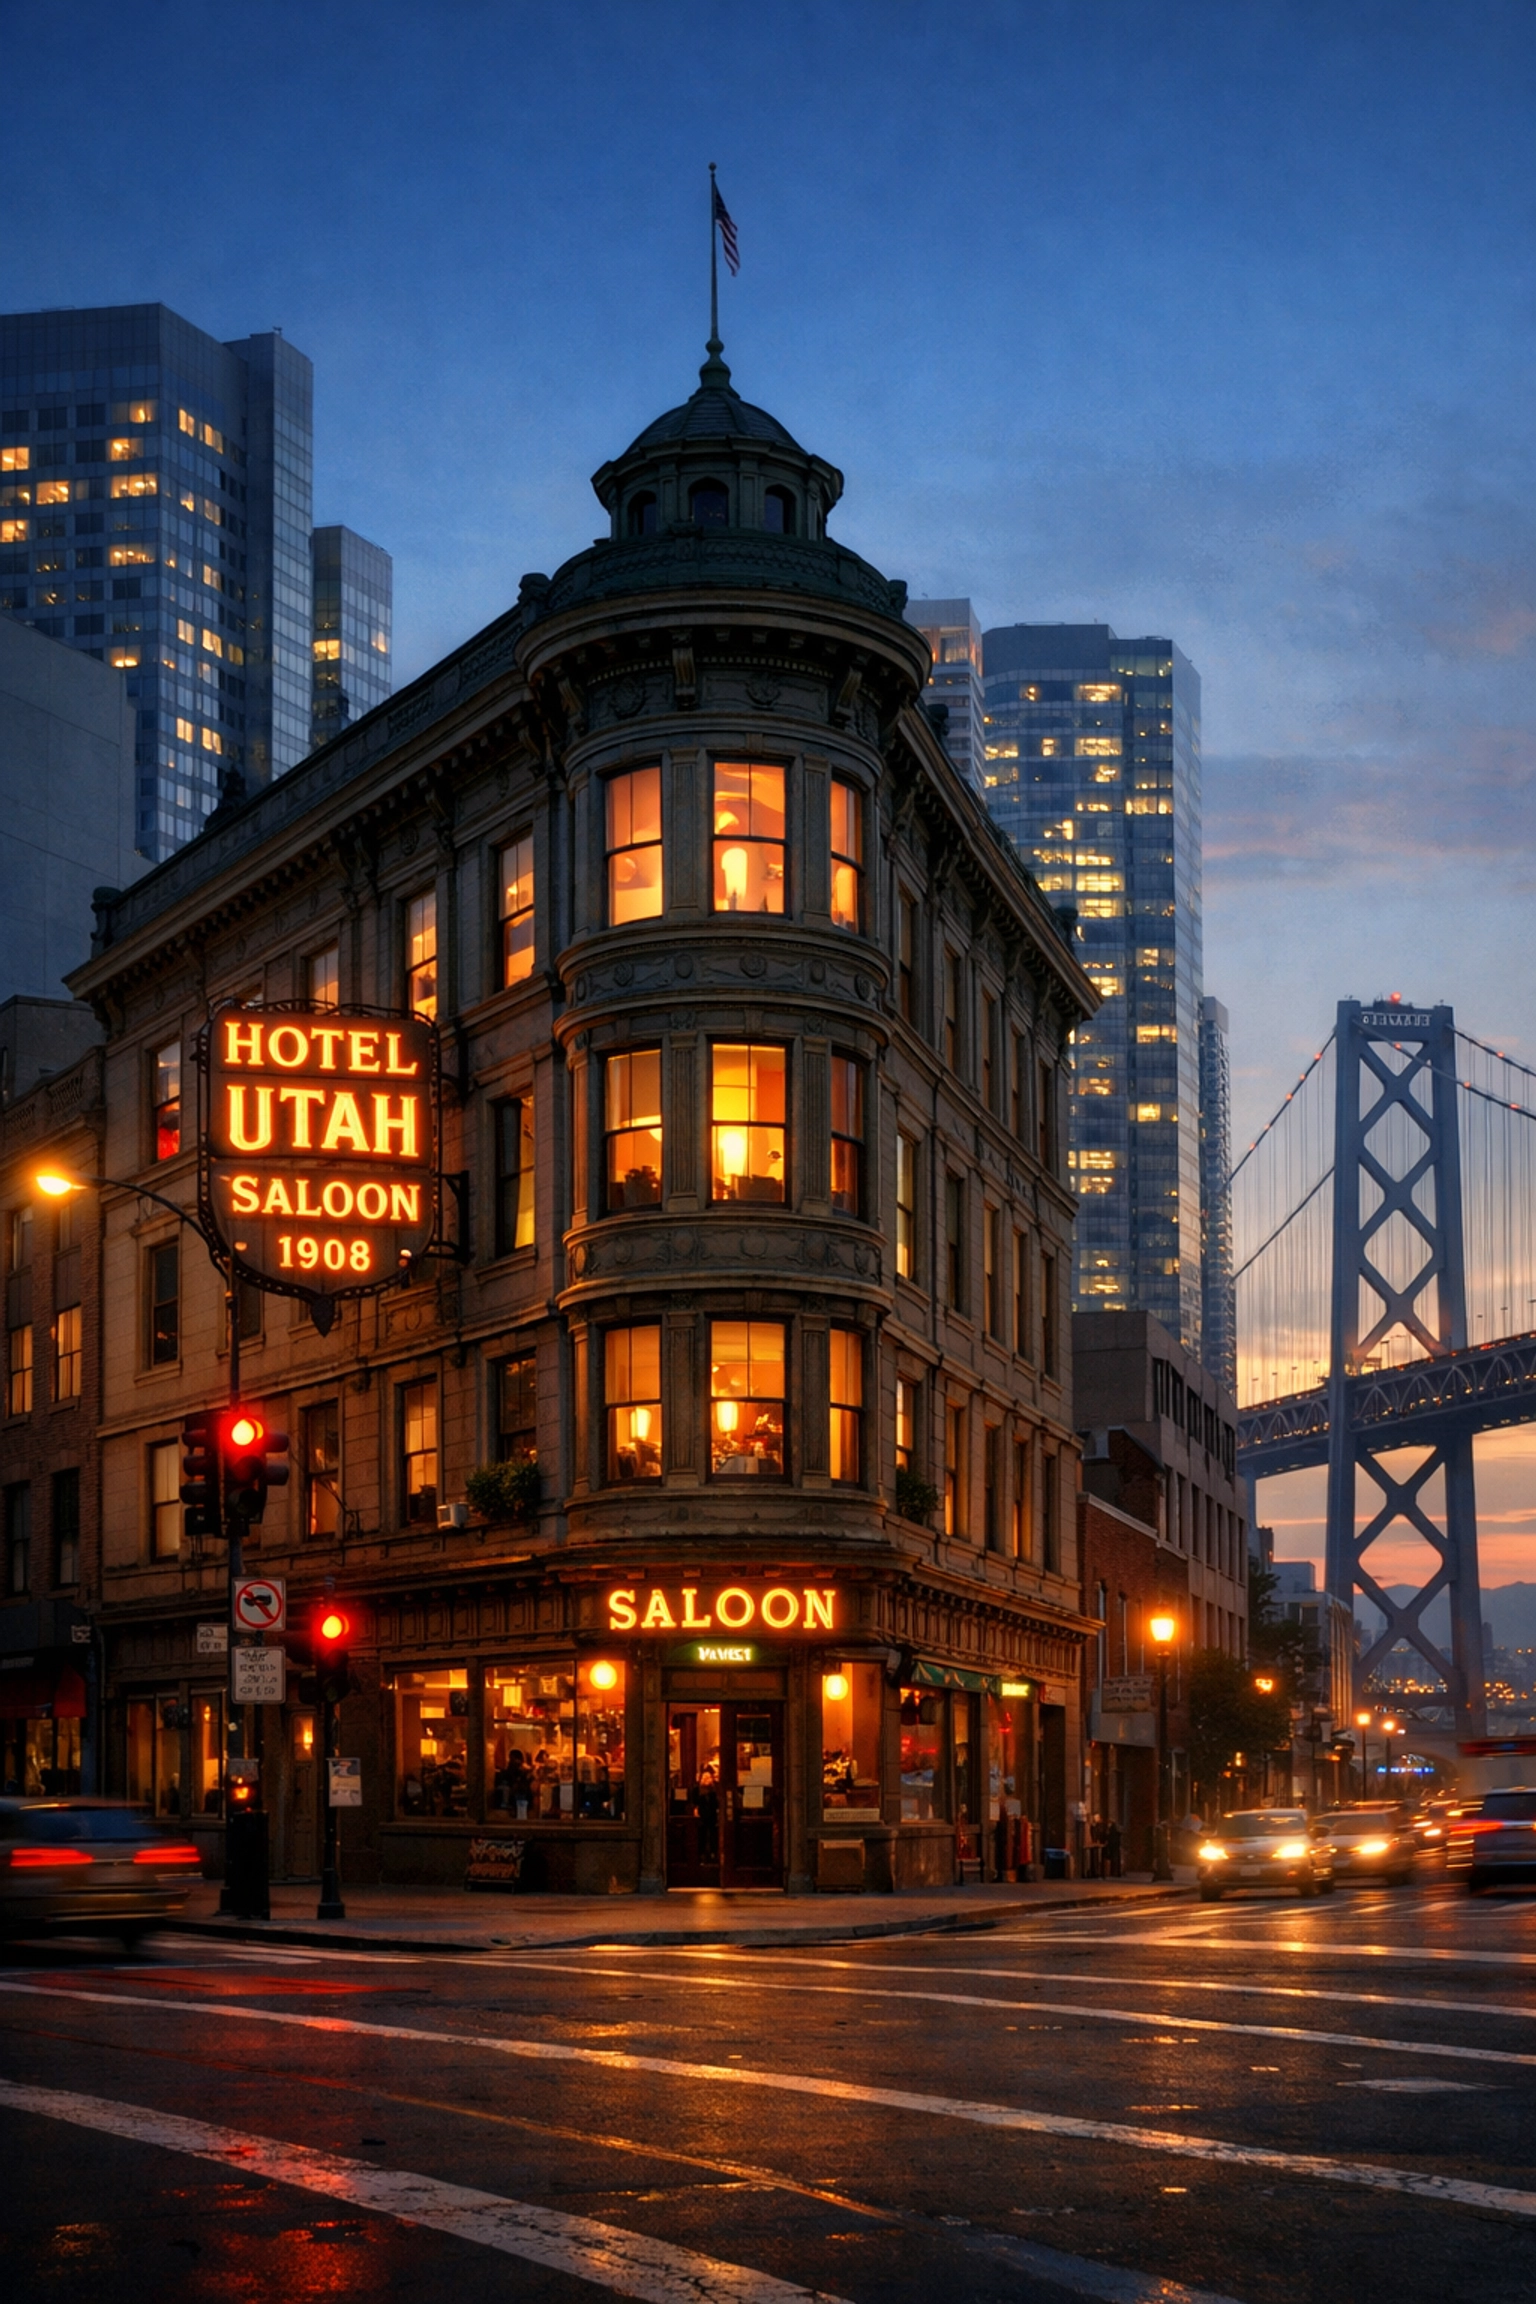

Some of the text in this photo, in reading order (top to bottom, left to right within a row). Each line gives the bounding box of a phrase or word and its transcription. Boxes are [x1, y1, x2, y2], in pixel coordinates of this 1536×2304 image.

[224, 1021, 418, 1075] HOTEL
[226, 1085, 419, 1157] UTAH
[231, 1175, 420, 1222] SALOON
[278, 1235, 371, 1272] 1908
[608, 1587, 836, 1630] SALOON
